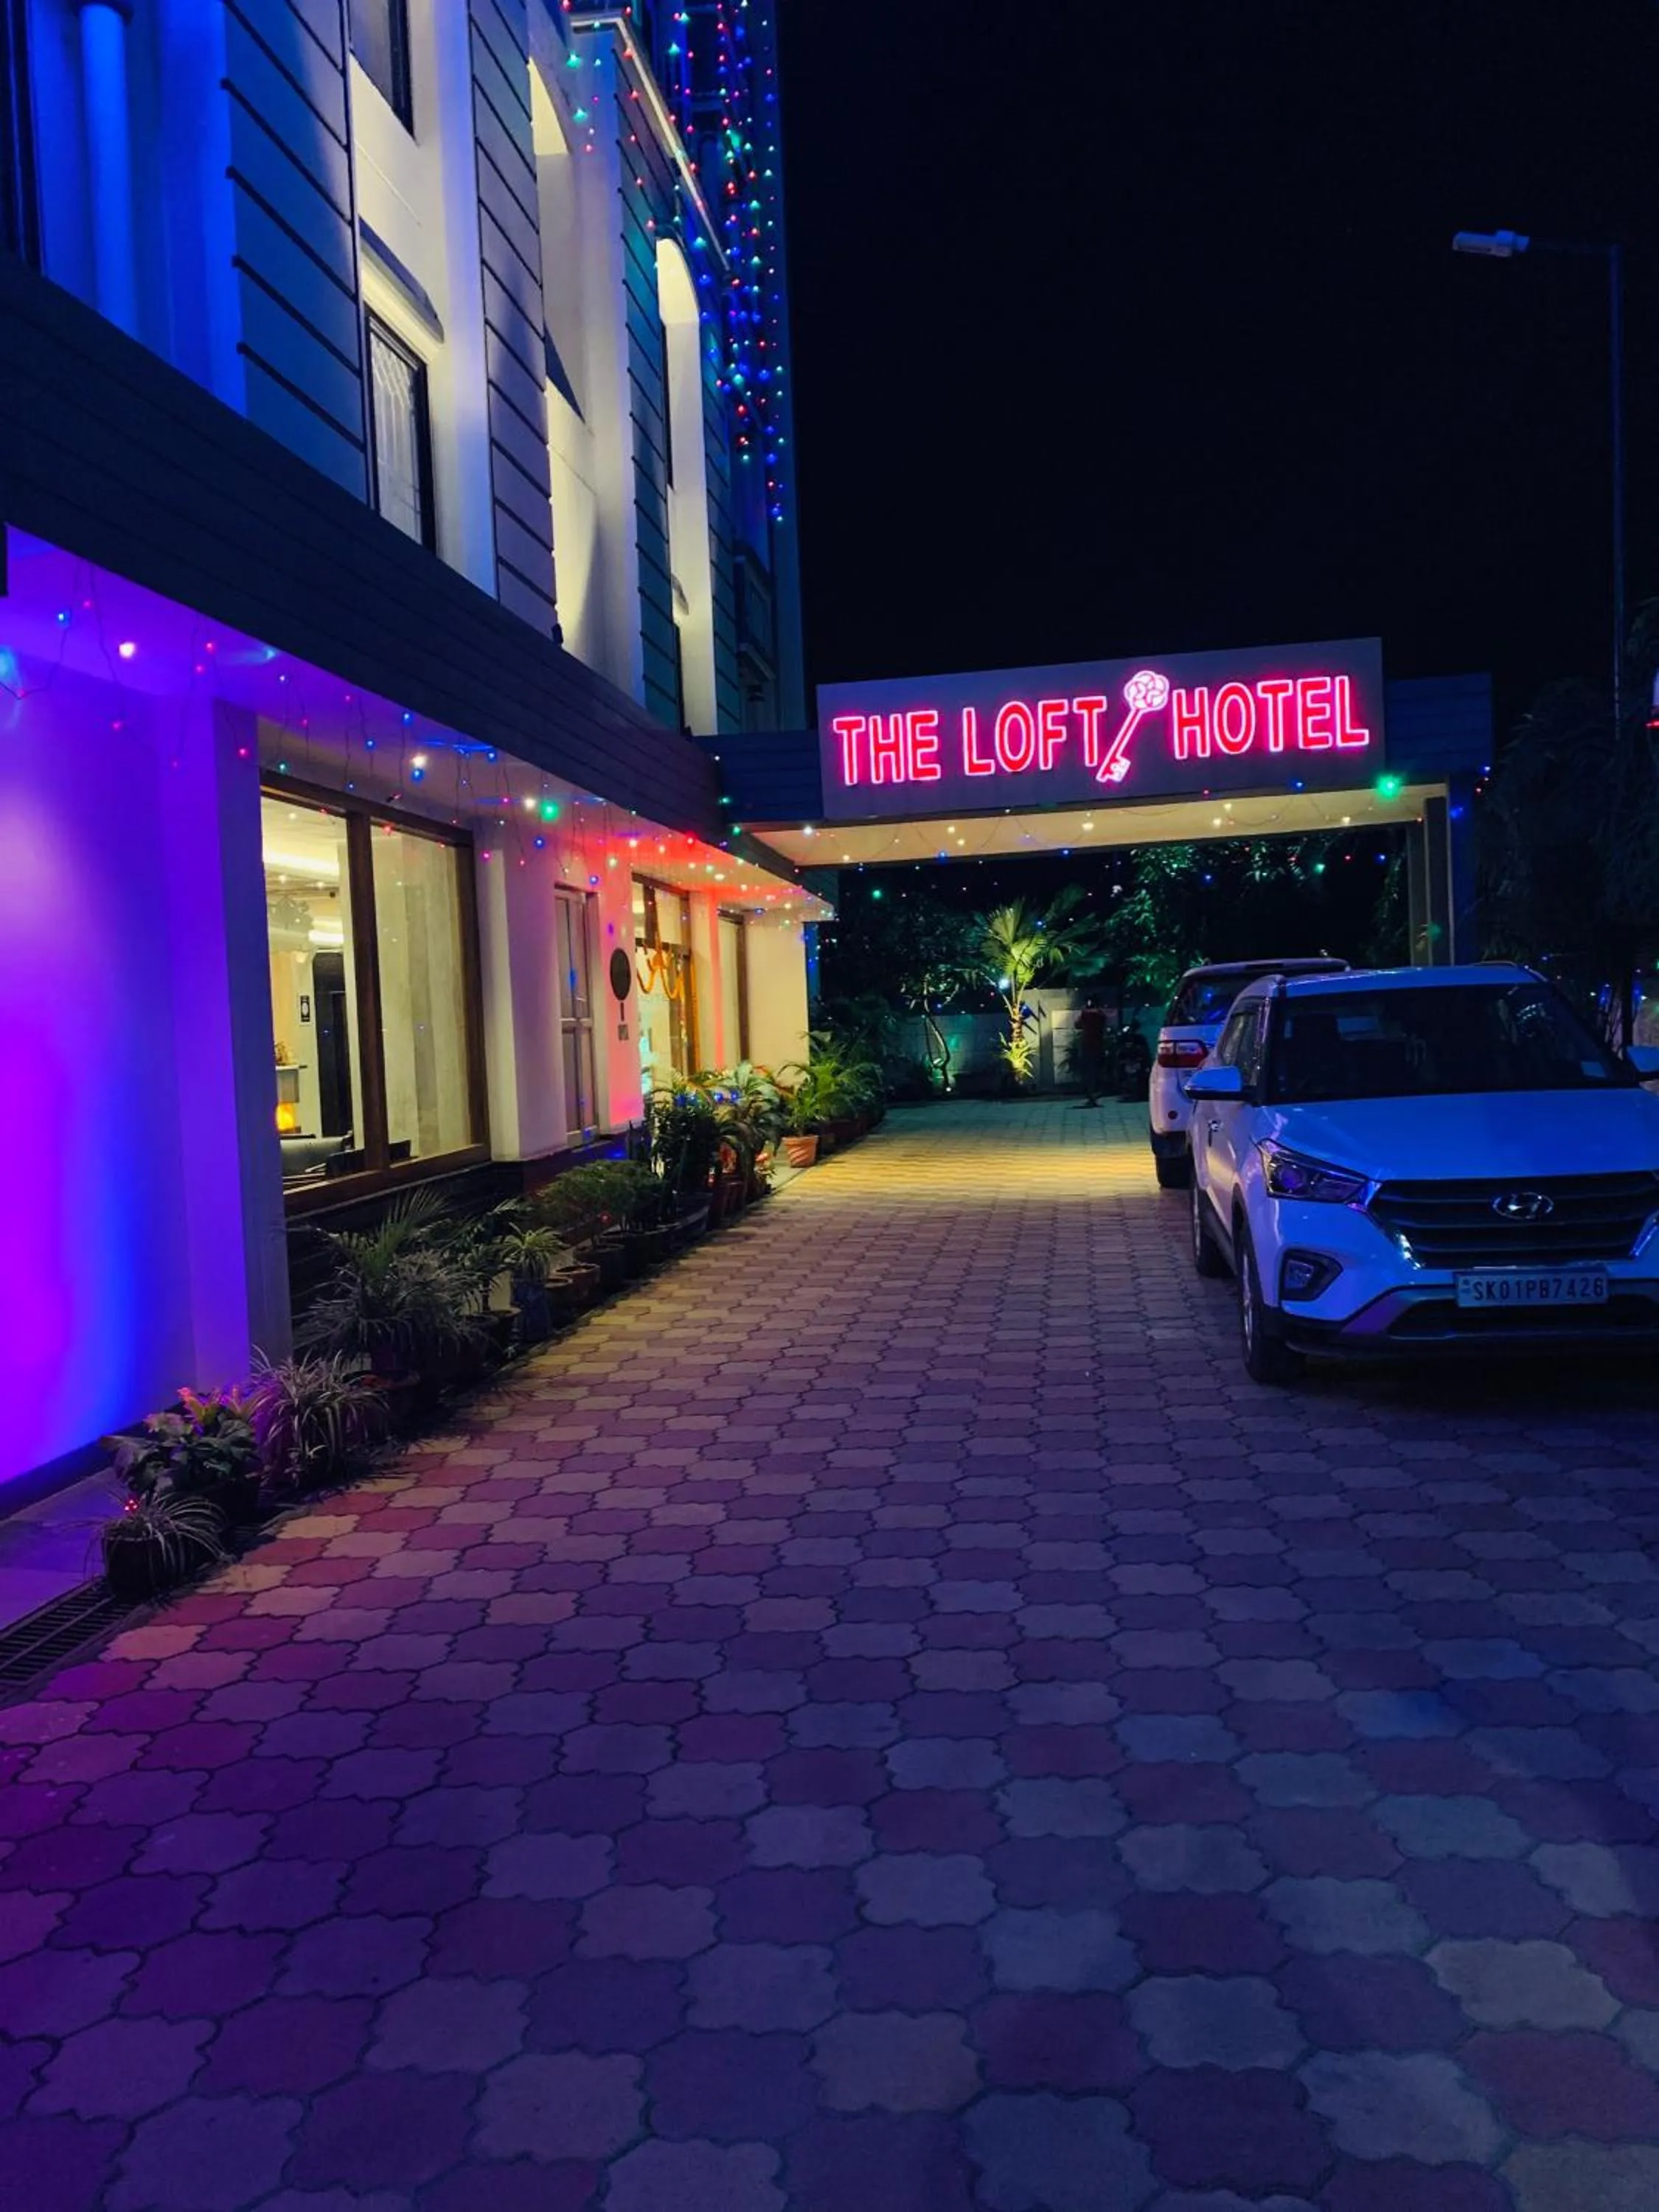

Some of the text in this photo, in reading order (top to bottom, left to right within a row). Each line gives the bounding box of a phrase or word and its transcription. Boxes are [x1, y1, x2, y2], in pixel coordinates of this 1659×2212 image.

[832, 675, 1370, 786] THE LOFT HOTEL
